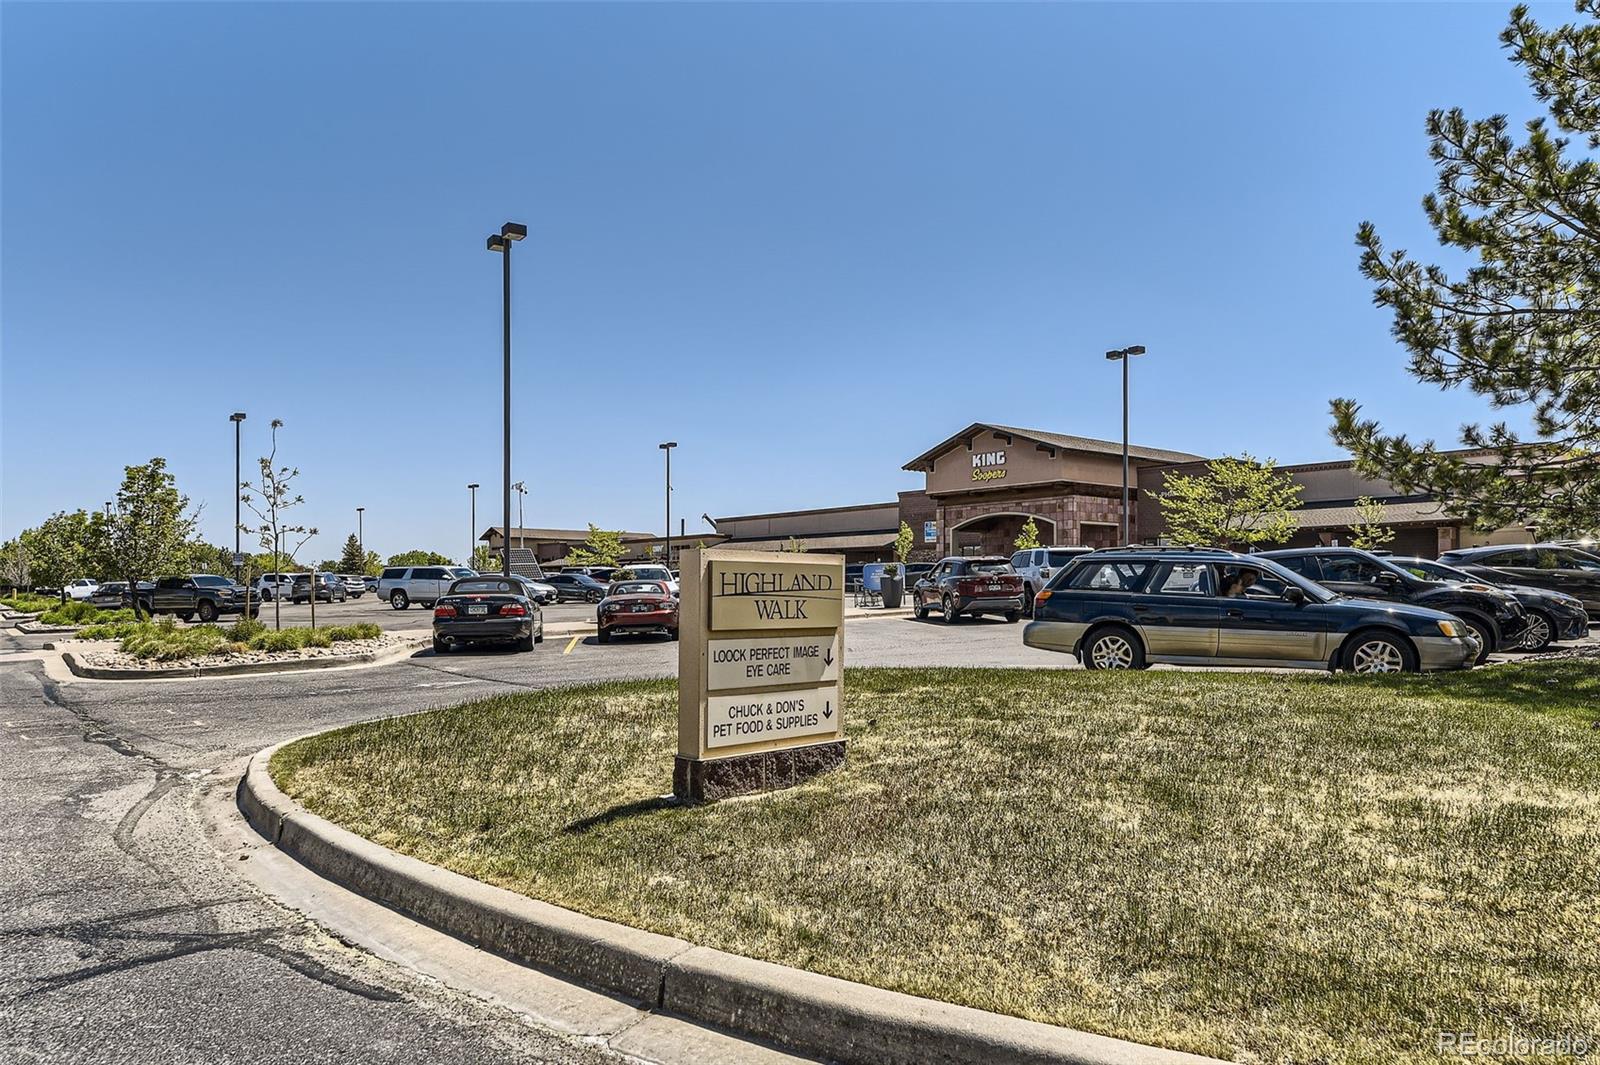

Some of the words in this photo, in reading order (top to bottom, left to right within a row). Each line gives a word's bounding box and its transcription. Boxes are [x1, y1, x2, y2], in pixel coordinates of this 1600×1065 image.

[972, 451, 1005, 467] KING
[971, 469, 1006, 482] Soopers
[720, 572, 832, 596] HIGHLAND
[755, 600, 808, 619] WALK
[713, 649, 746, 663] LOOCK
[749, 647, 790, 660] PERFECT
[793, 646, 819, 658] IMAGE
[746, 665, 763, 677] EYE
[766, 663, 791, 676] CARE
[728, 704, 763, 719] CHUCK
[766, 703, 773, 715] &
[776, 699, 805, 714] DON'S
[713, 723, 733, 738] PET
[736, 720, 763, 735] FOOD
[766, 720, 773, 731] &
[776, 714, 818, 730] SUPPLIES
